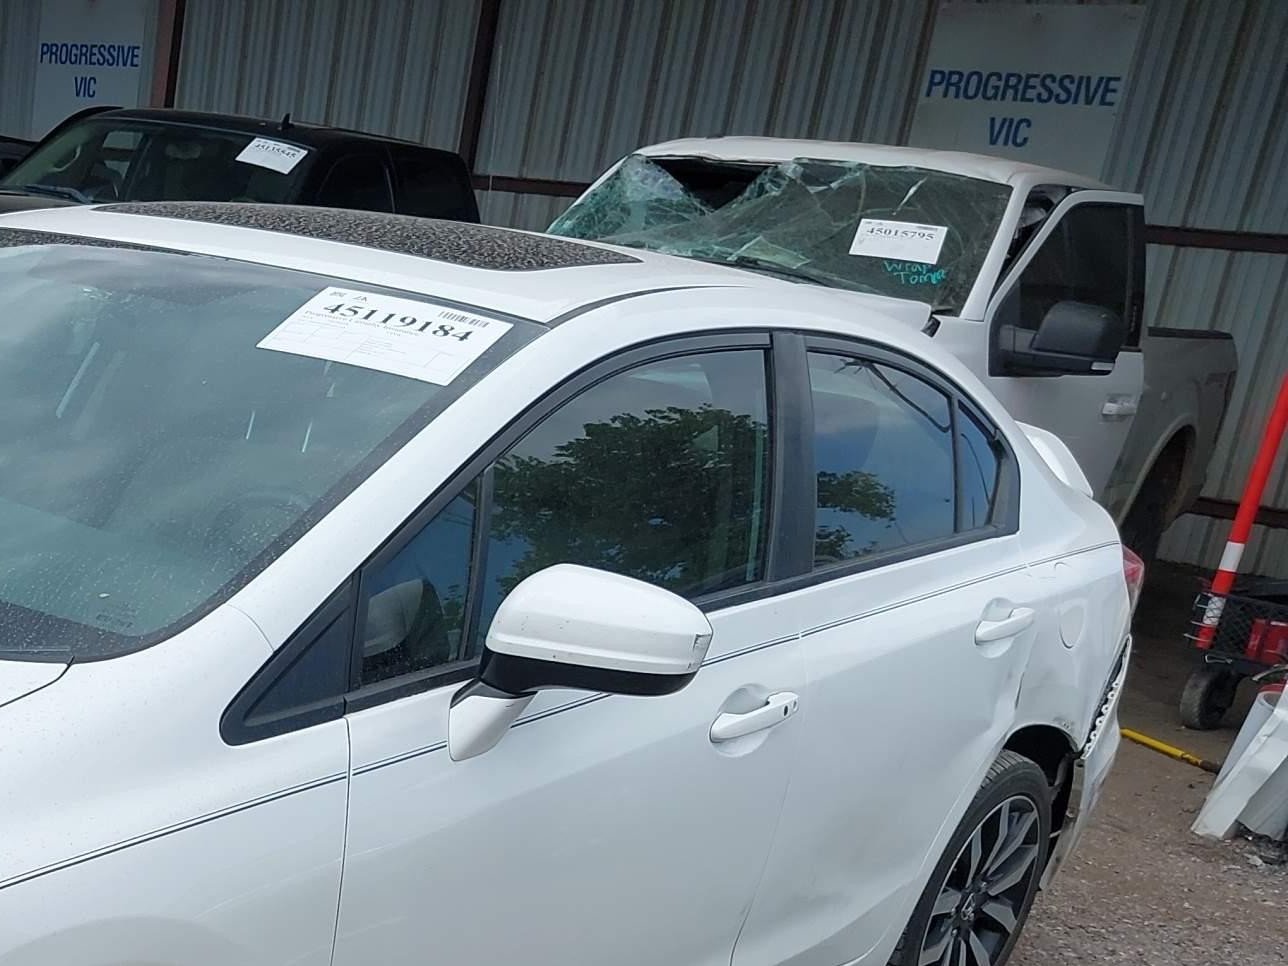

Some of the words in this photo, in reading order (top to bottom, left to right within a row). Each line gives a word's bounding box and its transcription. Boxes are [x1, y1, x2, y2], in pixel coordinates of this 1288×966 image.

[40, 43, 140, 67] PROGRESSIVE
[74, 76, 97, 98] VIC
[925, 69, 1121, 107] PROGRESSIVE
[988, 116, 1032, 148] VIC
[866, 227, 936, 241] 45015795
[322, 302, 475, 343] 45119184
